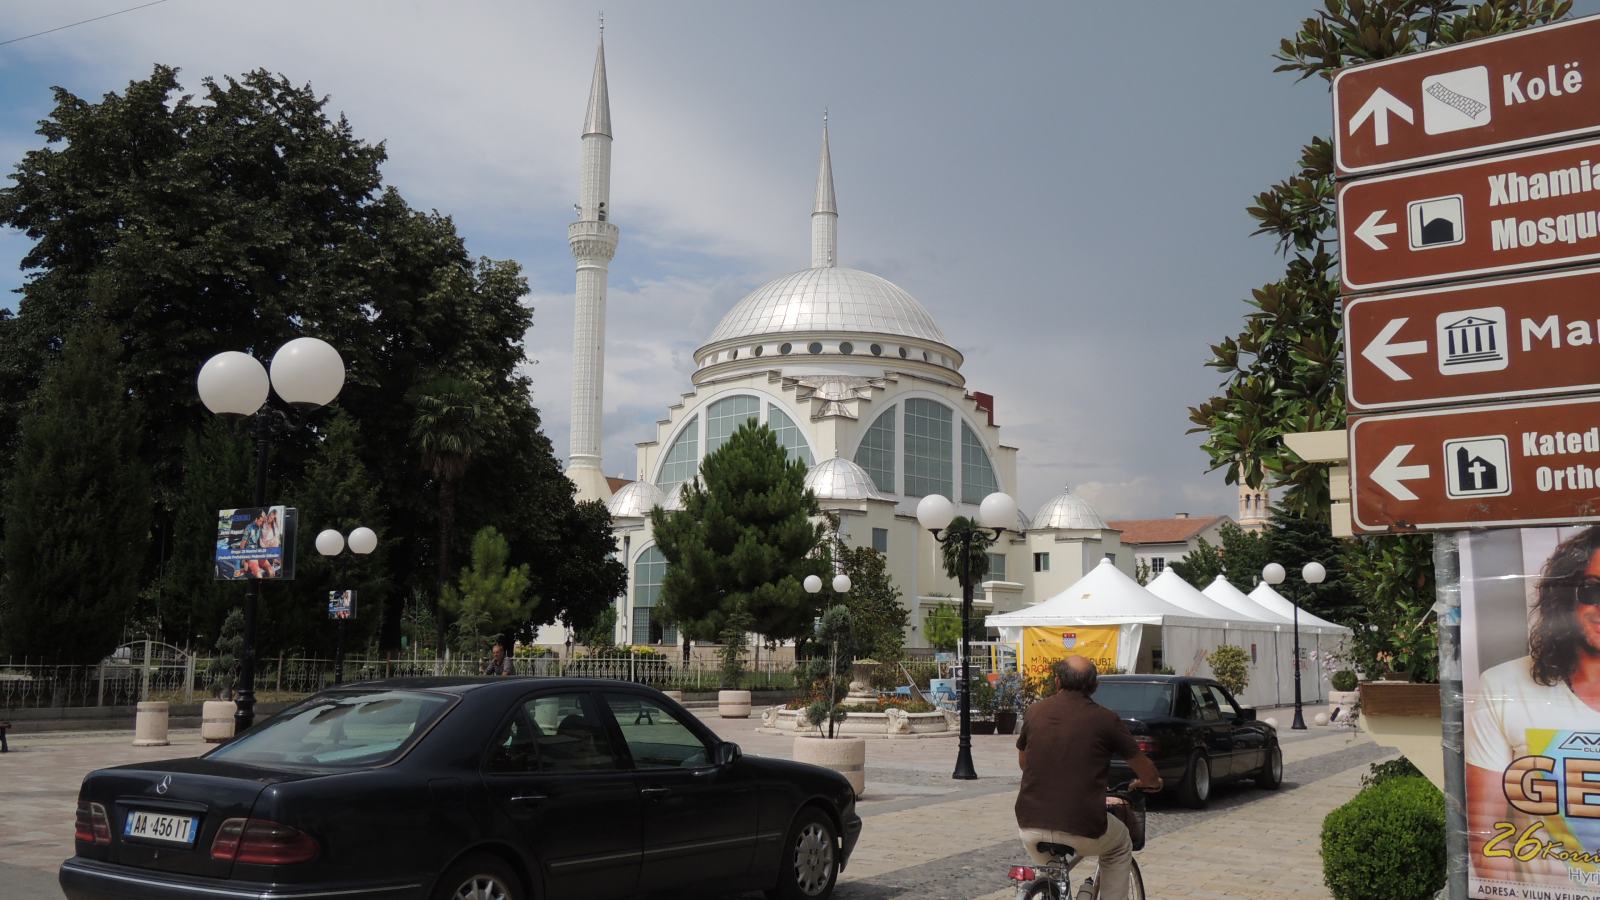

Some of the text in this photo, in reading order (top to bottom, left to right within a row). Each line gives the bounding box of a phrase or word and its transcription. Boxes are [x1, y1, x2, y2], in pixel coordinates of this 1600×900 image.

[1502, 61, 1583, 107] Kolë
[1490, 210, 1600, 251] Mosqu
[1520, 315, 1600, 352] Ma
[1568, 735, 1600, 745] AV
[134, 815, 190, 839] AA 456 IT
[1483, 820, 1544, 861] 26
[1478, 885, 1519, 898] ADRESA:
